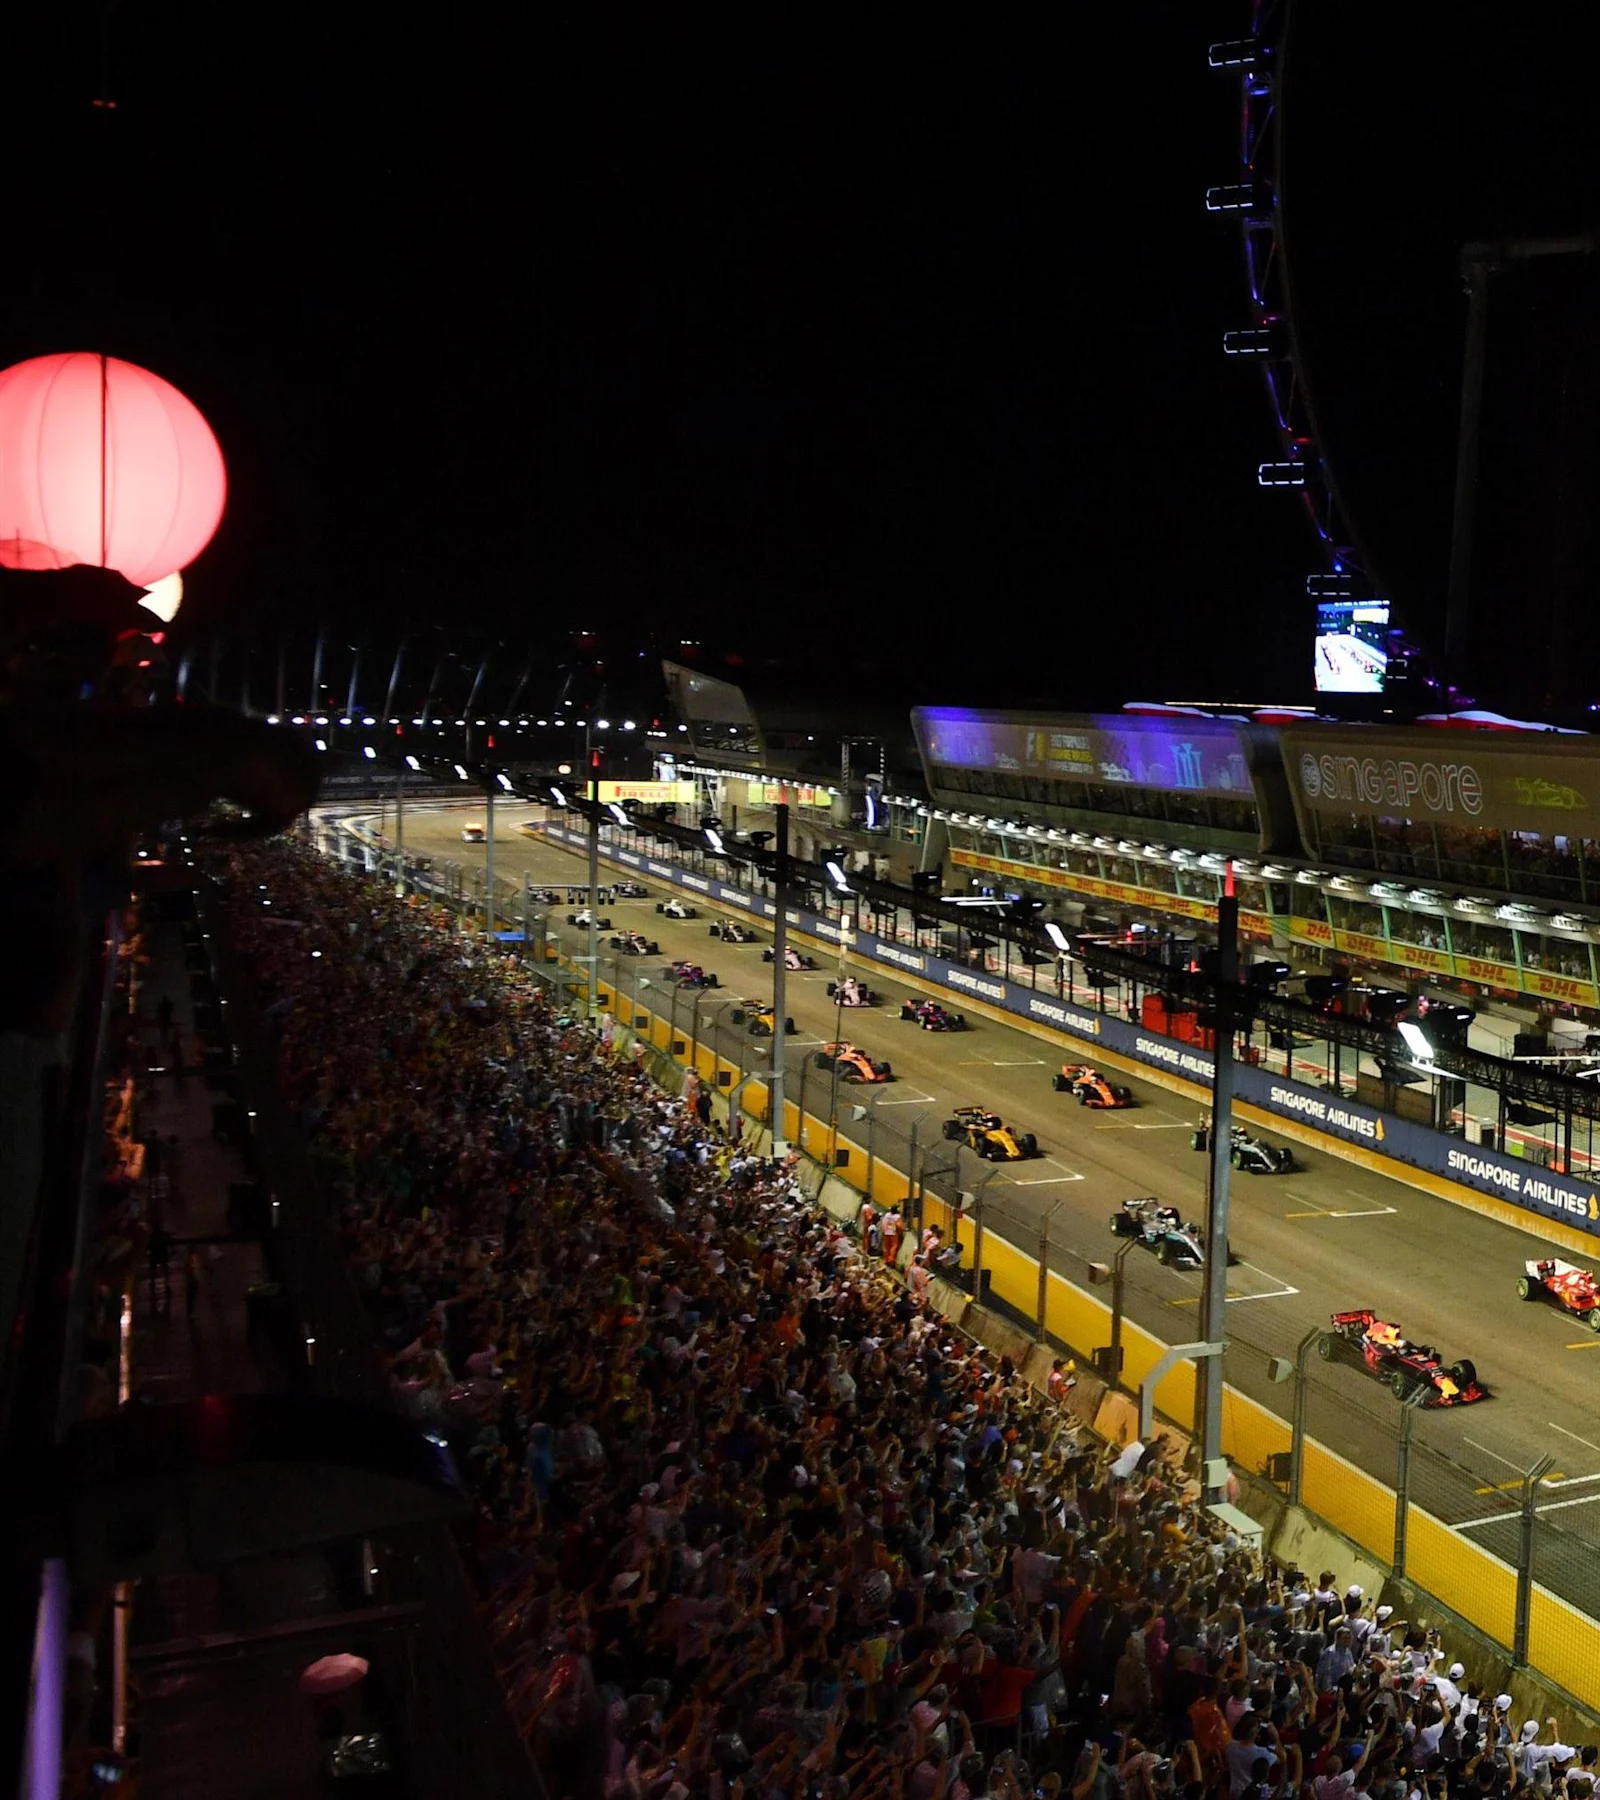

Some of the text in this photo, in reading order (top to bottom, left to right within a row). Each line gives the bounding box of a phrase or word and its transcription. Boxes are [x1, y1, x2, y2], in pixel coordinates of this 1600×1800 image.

[1347, 934, 1380, 955] DHL
[1404, 949, 1440, 968] DHL
[1468, 962, 1507, 985] DHL
[1539, 977, 1583, 999] DHL
[1030, 1000, 1094, 1033] SINGAPORE AIRLINES
[1136, 1037, 1215, 1078] SINGAPORE AIRLINES
[1270, 1086, 1375, 1138] SINGAPORE AIRLINES
[1448, 1150, 1588, 1217] SINGAPORE AIRLINES
